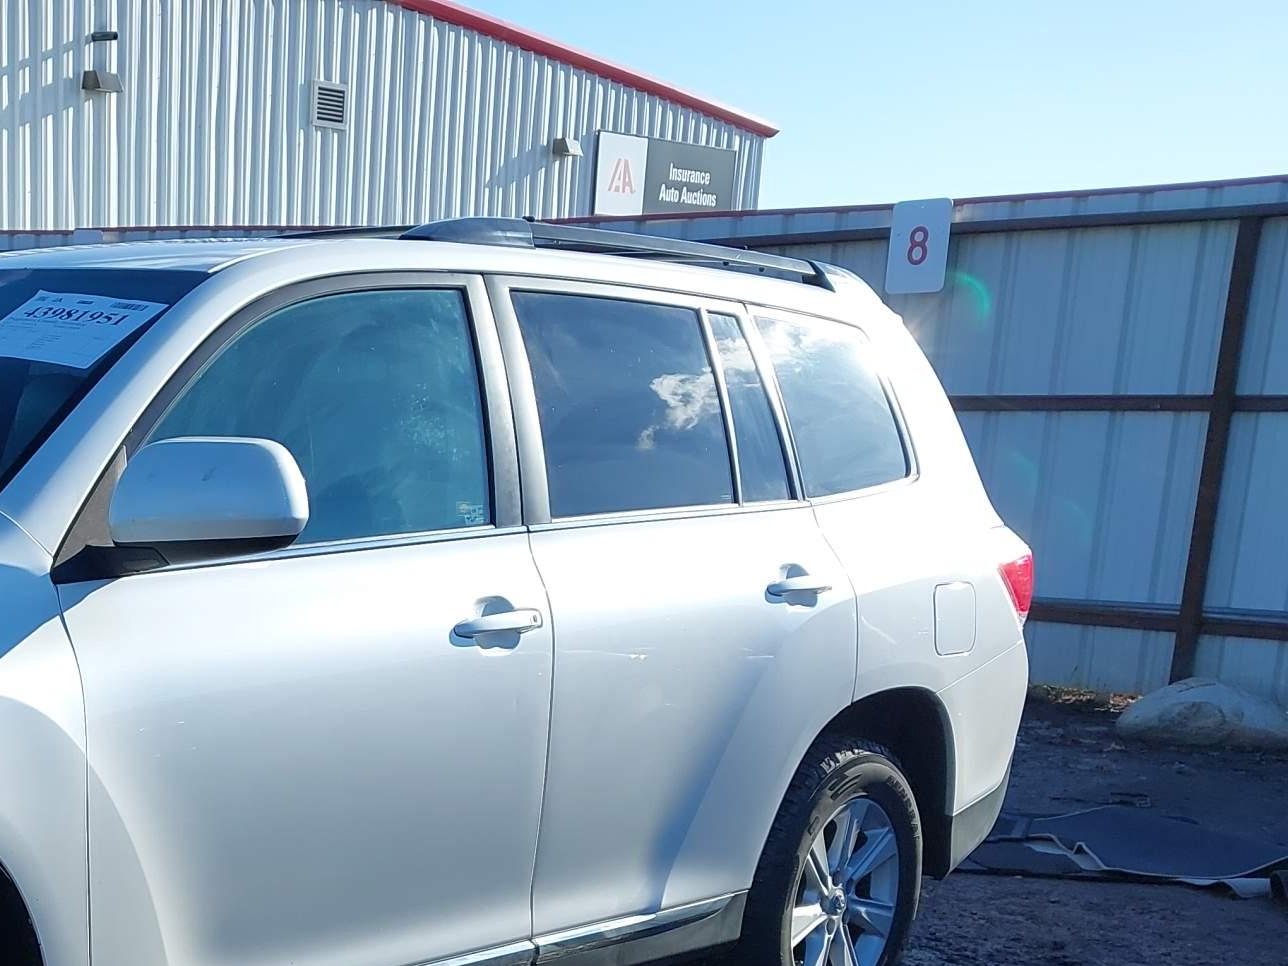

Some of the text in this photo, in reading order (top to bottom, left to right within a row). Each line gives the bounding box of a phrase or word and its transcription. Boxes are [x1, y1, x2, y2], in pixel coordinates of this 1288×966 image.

[669, 162, 711, 185] Insurance
[659, 183, 717, 207] Auto Auctions
[907, 226, 929, 266] 8
[24, 306, 129, 326] 43981951
